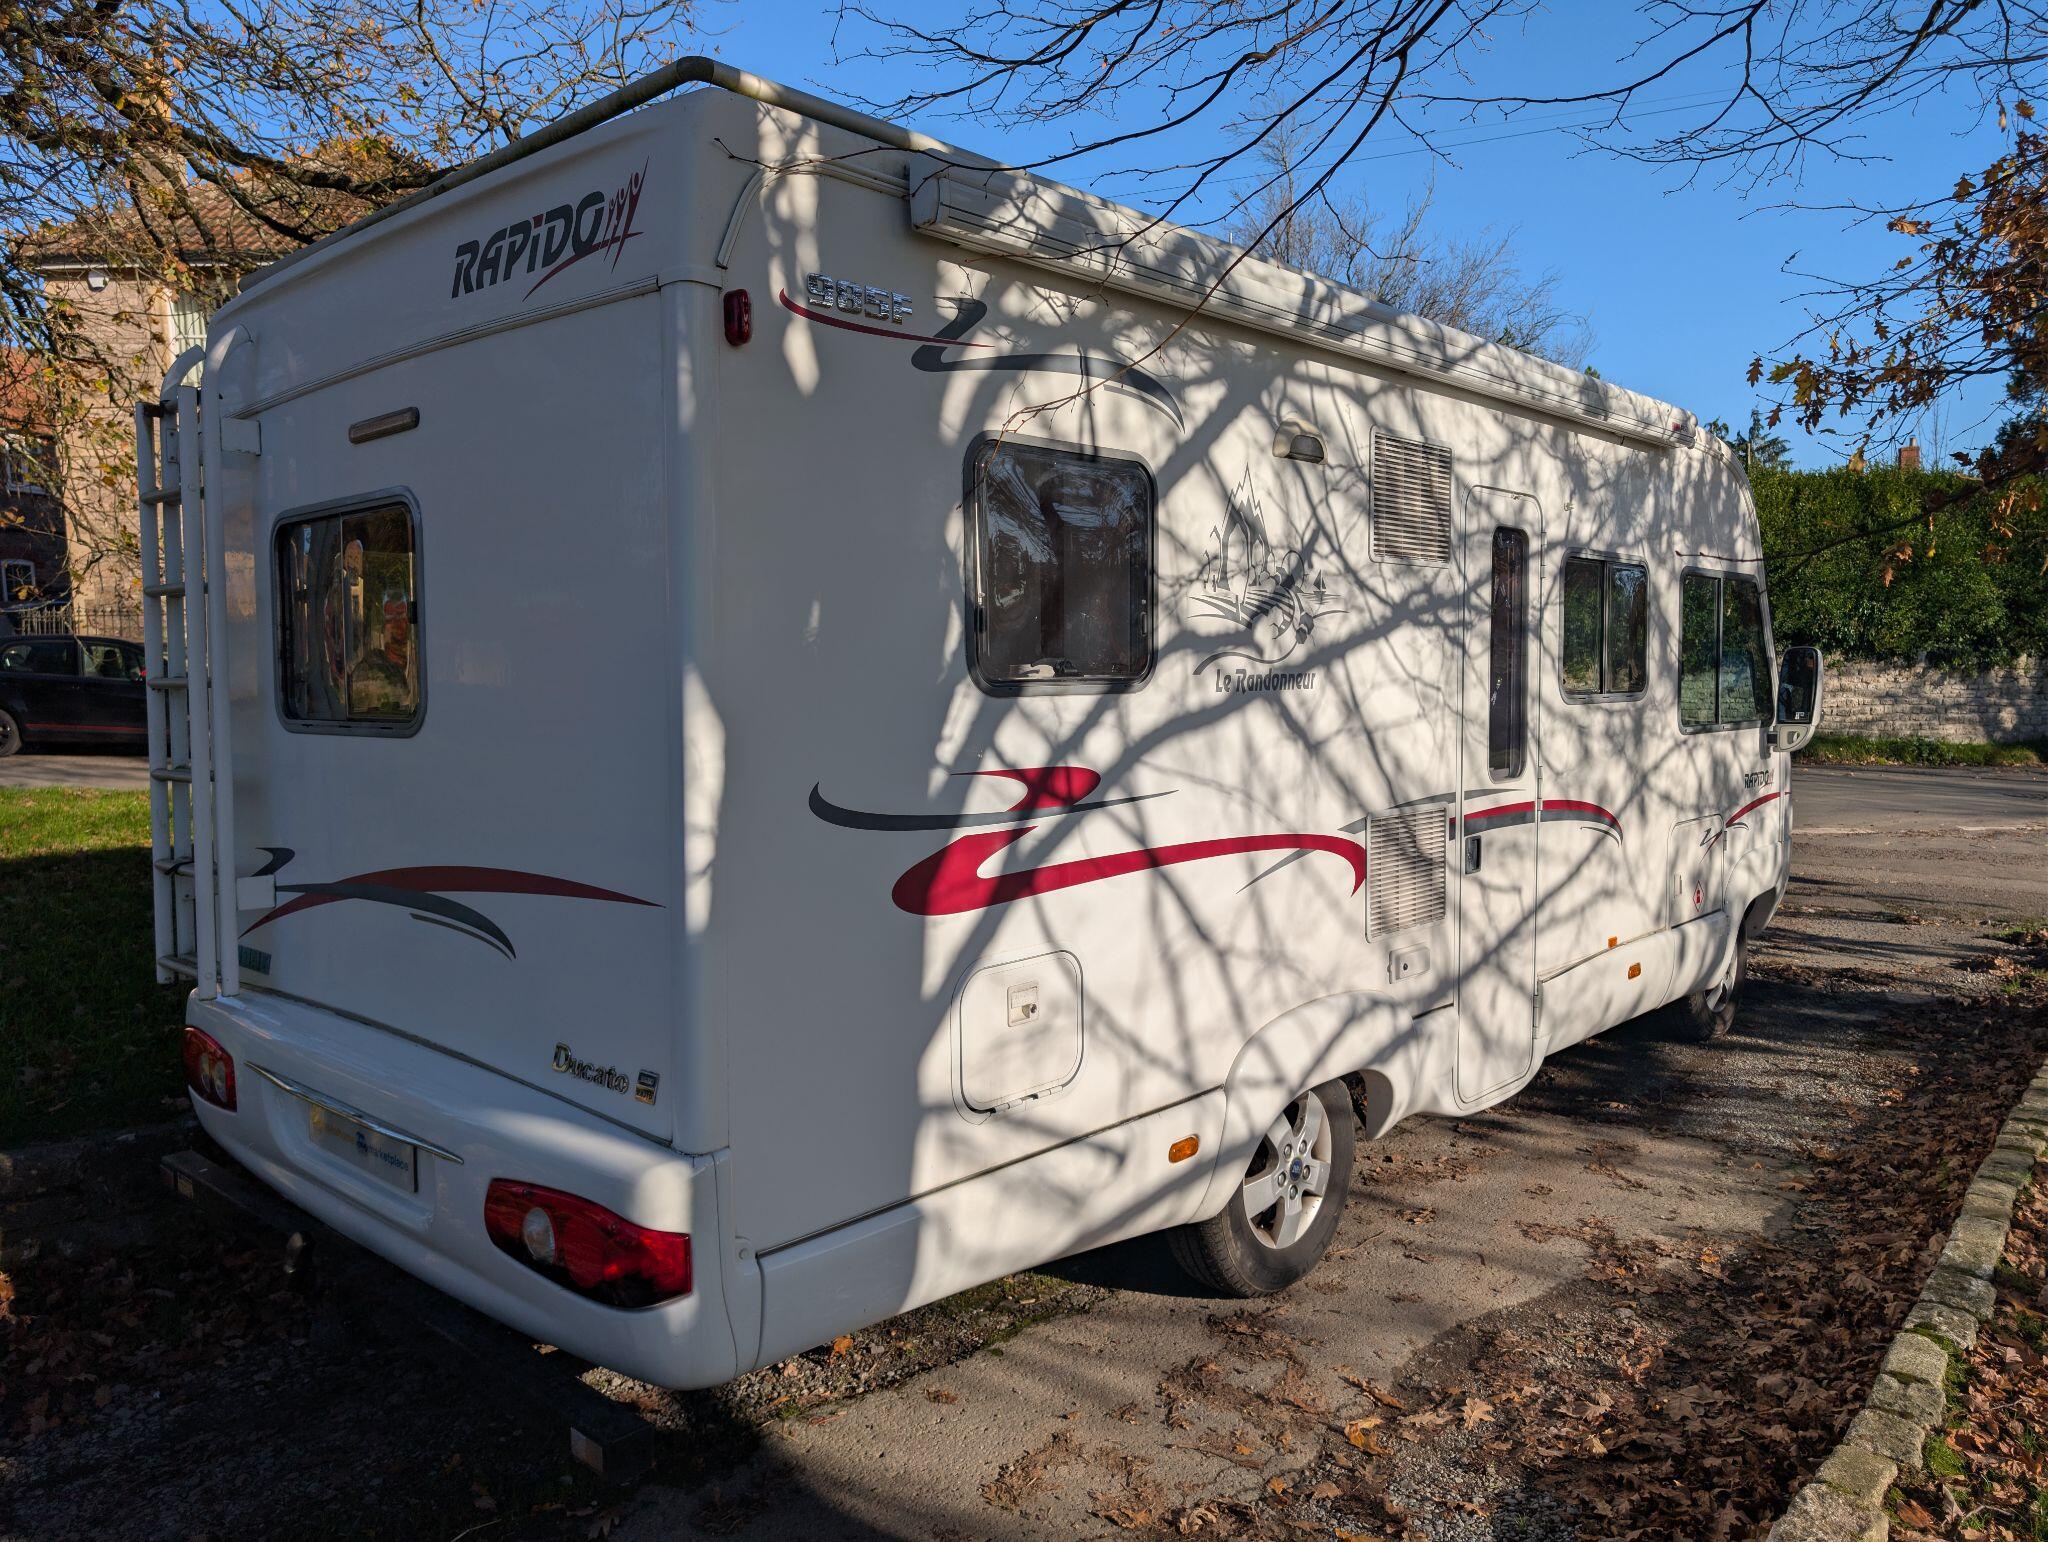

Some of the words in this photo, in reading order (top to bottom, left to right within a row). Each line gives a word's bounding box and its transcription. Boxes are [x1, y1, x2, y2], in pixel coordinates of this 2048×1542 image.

[806, 272, 913, 325] 985F
[1215, 668, 1232, 692] Le
[1235, 667, 1317, 695] Randonneur
[552, 1042, 630, 1094] Ducato
